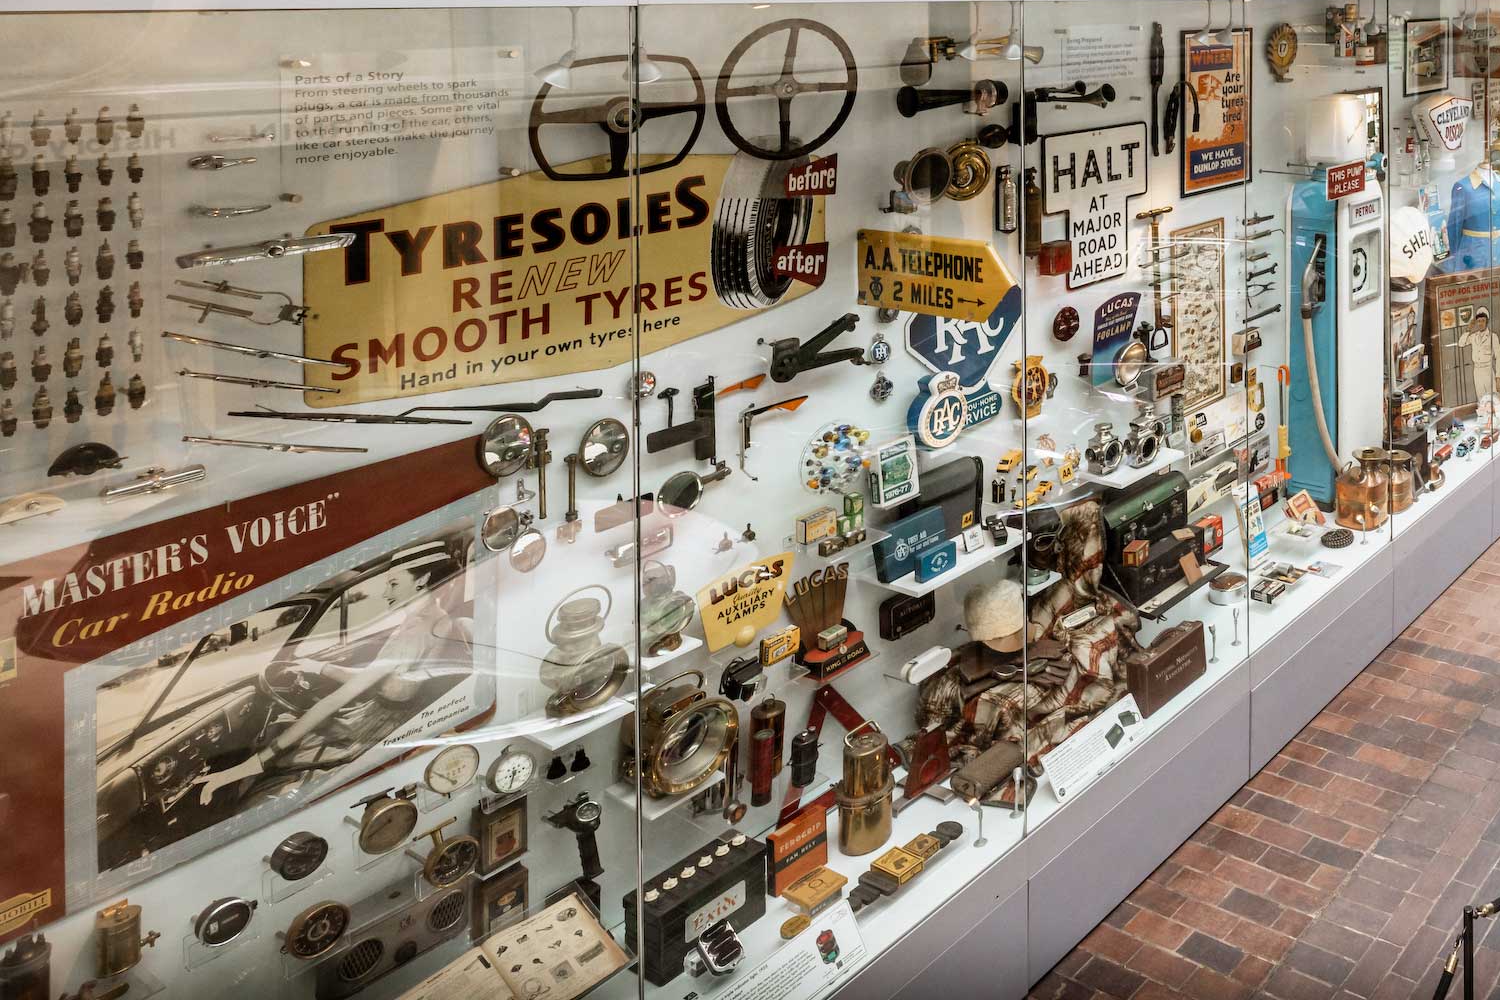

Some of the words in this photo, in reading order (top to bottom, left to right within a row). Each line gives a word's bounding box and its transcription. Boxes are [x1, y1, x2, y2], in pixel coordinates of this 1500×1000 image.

[295, 75, 331, 85] Parts
[336, 72, 352, 83] of
[355, 73, 363, 81] a
[368, 71, 404, 83] Story
[295, 88, 328, 98] From
[332, 85, 383, 98] steering
[387, 81, 428, 93] wheels
[432, 81, 444, 90] to
[447, 79, 478, 91] spark
[1224, 71, 1240, 83] Are
[295, 101, 333, 113] plugs,
[349, 99, 367, 108] car
[372, 97, 381, 106] is
[384, 94, 418, 106] made
[422, 92, 449, 104] from
[453, 88, 510, 101] thousands
[1222, 84, 1244, 96] your
[295, 114, 308, 125] of
[313, 112, 345, 125] parts
[349, 109, 374, 121] and
[377, 107, 416, 120] pieces.
[420, 105, 452, 115] Some
[455, 104, 473, 112] are
[476, 101, 500, 111] vital
[1221, 97, 1245, 109] tyres
[296, 127, 309, 138] to
[313, 124, 335, 136] the
[339, 121, 389, 136] running
[392, 119, 405, 130] of
[409, 117, 428, 128] the
[454, 113, 493, 125] others,
[1223, 111, 1242, 122] tired
[1437, 106, 1470, 125] CLEVELAND
[295, 139, 319, 151] like
[322, 138, 341, 149] car
[345, 135, 390, 147] stereos
[394, 131, 426, 143] make
[449, 126, 495, 139] journey
[1229, 125, 1235, 135] ?
[295, 153, 330, 165] more
[334, 145, 399, 161] enjoyable.
[1194, 160, 1219, 174] DUNLOP
[1221, 157, 1242, 169] STOCKS
[1201, 151, 1214, 161] WE
[1215, 148, 1234, 160] HAVE
[1053, 142, 1140, 193] HALT
[1331, 170, 1346, 182] THIS
[1347, 165, 1363, 179] PUMP
[788, 166, 836, 194] before
[1334, 179, 1360, 195] PLEASE
[1089, 194, 1108, 213] AT
[1355, 204, 1376, 218] PETROL
[331, 175, 709, 286] TYRESOLES
[1073, 212, 1122, 238] MAJOR
[1078, 234, 1117, 258] ROAD
[777, 246, 825, 276] after
[865, 245, 897, 272] A.A.
[899, 248, 983, 283] TELEPHONE
[1073, 253, 1123, 281] AHEAD
[893, 281, 903, 301] 2
[911, 283, 954, 309] MILES
[1440, 289, 1457, 298] STOP
[1459, 286, 1471, 295] FOR
[1473, 281, 1499, 292] SERVICE
[1101, 297, 1134, 318] LUCAS
[331, 302, 550, 381] SMOOTH
[576, 271, 709, 326] TYRES
[1096, 320, 1132, 343] FOGLAMP
[401, 365, 457, 390] Hand
[465, 358, 483, 377] in
[491, 347, 539, 374] your
[545, 336, 585, 356] own
[589, 323, 635, 348] tyres
[642, 313, 681, 335] here
[934, 315, 1004, 365] RAC
[932, 399, 960, 436] RAC
[965, 402, 998, 426] RVICE
[1062, 467, 1071, 478] AA
[884, 485, 909, 500] 1976-77
[908, 534, 919, 545] FIRST
[21, 533, 209, 619] MASTER'S
[709, 559, 784, 605] LUCAS
[784, 562, 849, 606] LUCAS
[52, 610, 129, 648] Car
[140, 571, 255, 622] Radio
[717, 588, 775, 620] AUXILIARY
[726, 601, 766, 625] LAMPS
[826, 659, 842, 672] KING
[847, 647, 864, 661] ROAD
[421, 710, 434, 720] The
[438, 695, 466, 711] perfect
[383, 725, 424, 747] Travelling
[427, 705, 470, 728] Companion
[779, 821, 822, 854] FEROGRIP
[785, 852, 798, 863] FAN
[801, 840, 817, 855] BELT
